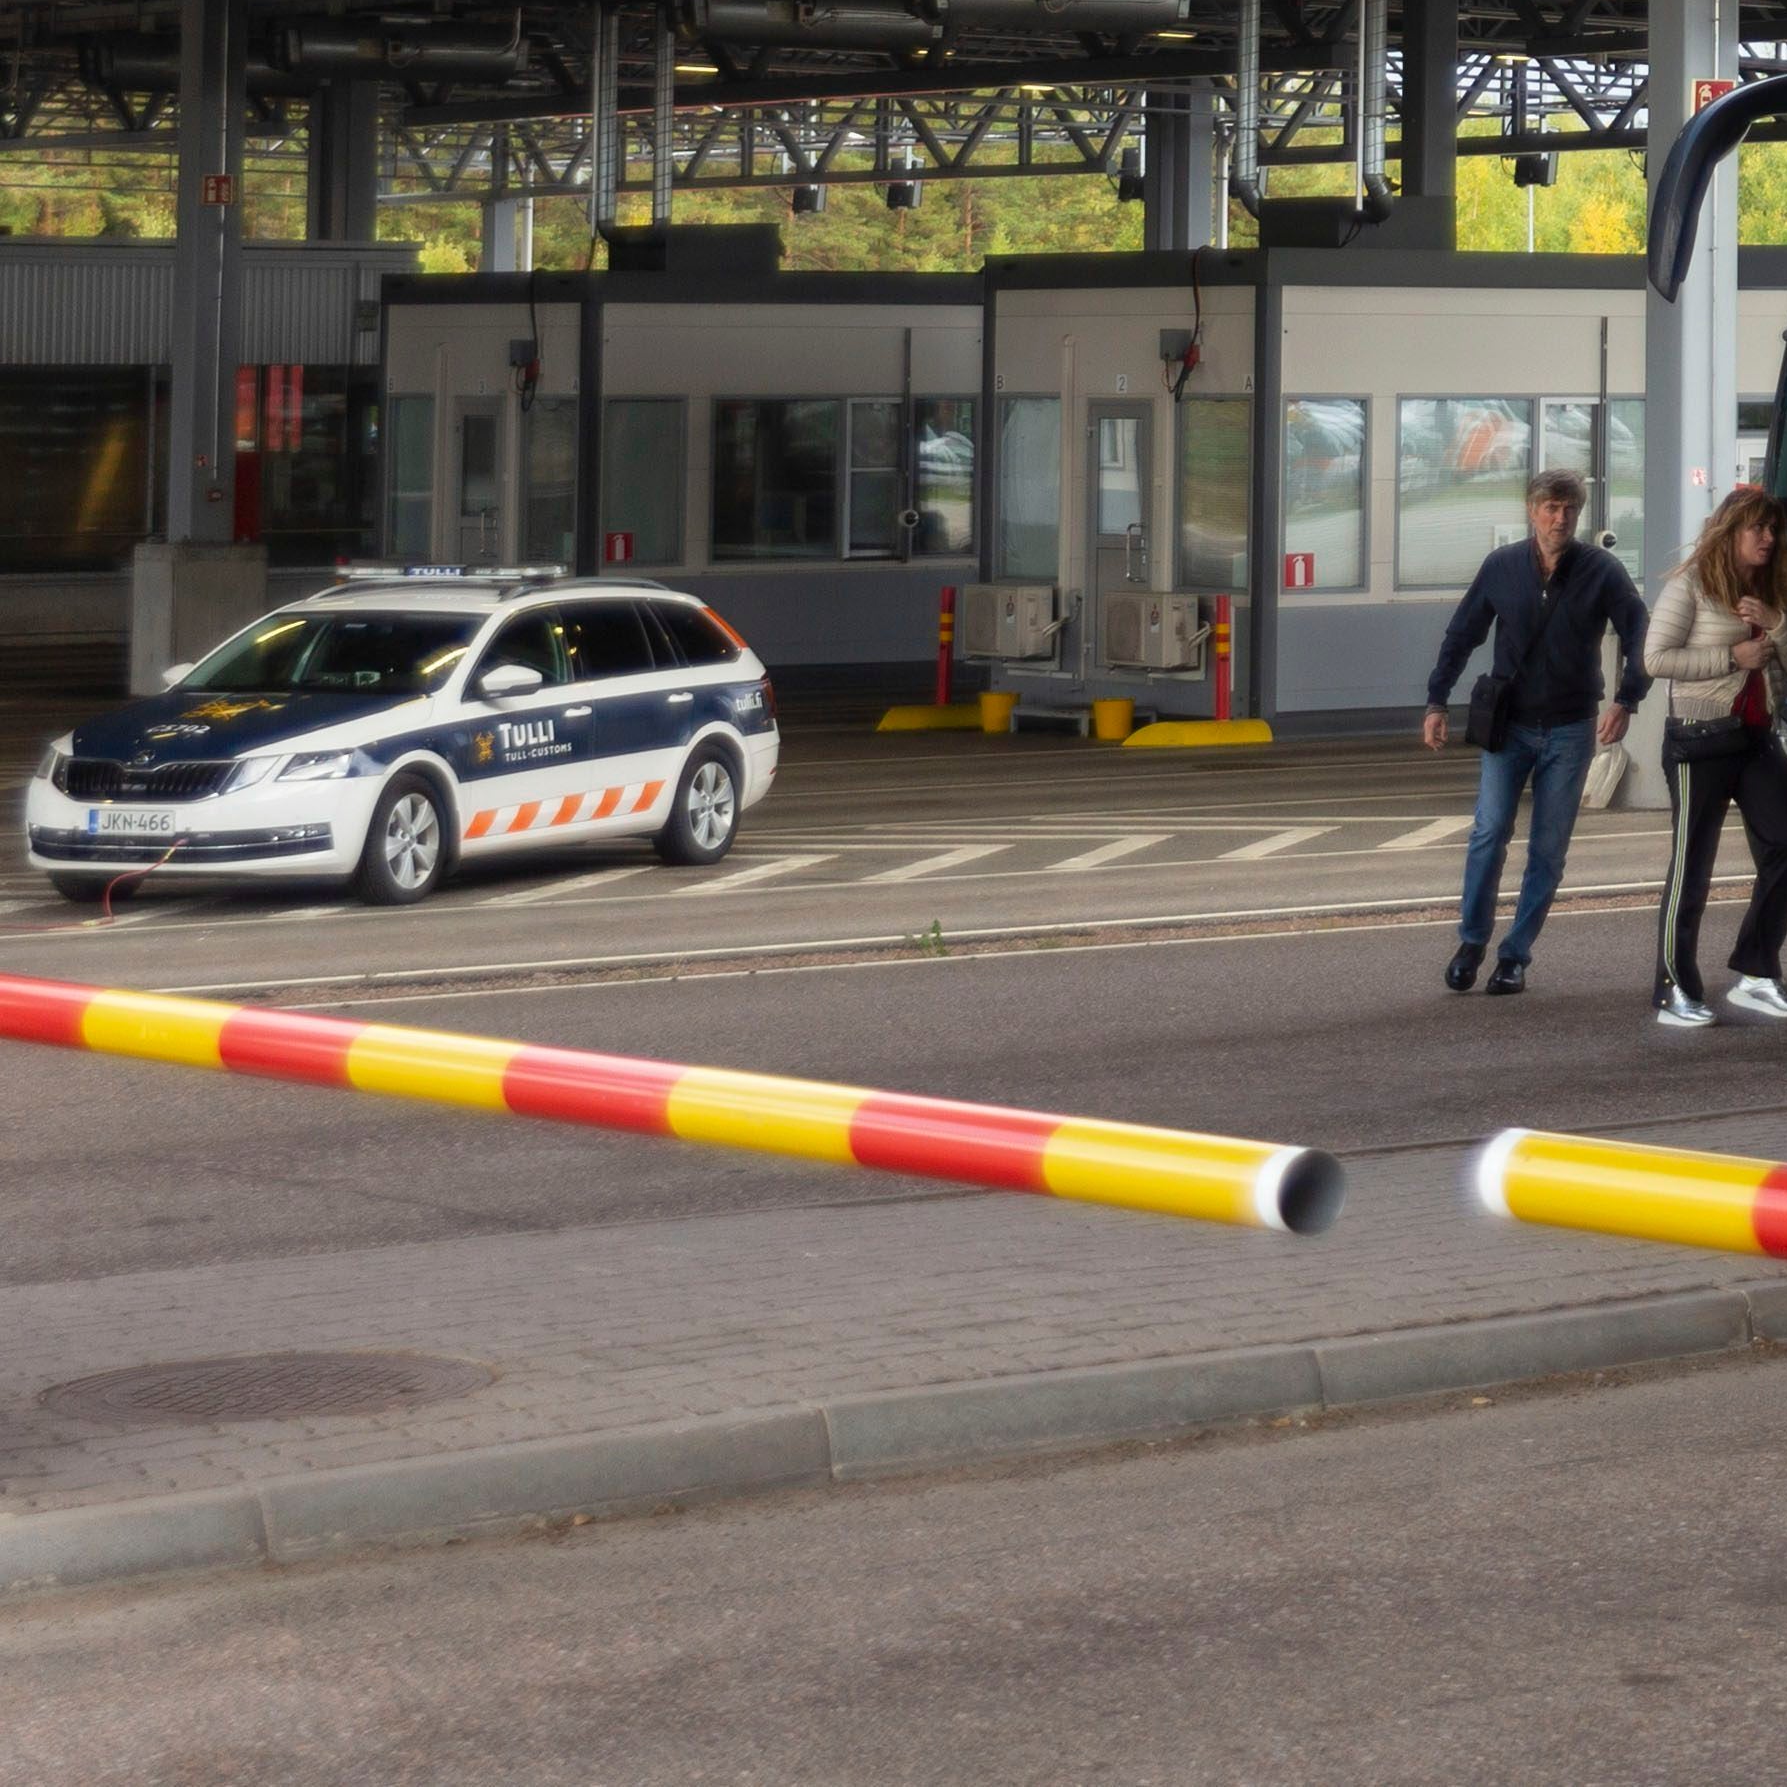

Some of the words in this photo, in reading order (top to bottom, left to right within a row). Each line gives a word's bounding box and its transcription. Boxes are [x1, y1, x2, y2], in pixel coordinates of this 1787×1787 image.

[1118, 376, 1127, 392] 2
[1245, 376, 1253, 391] A
[411, 567, 461, 576] TULLI
[102, 814, 170, 831] JKN-466
